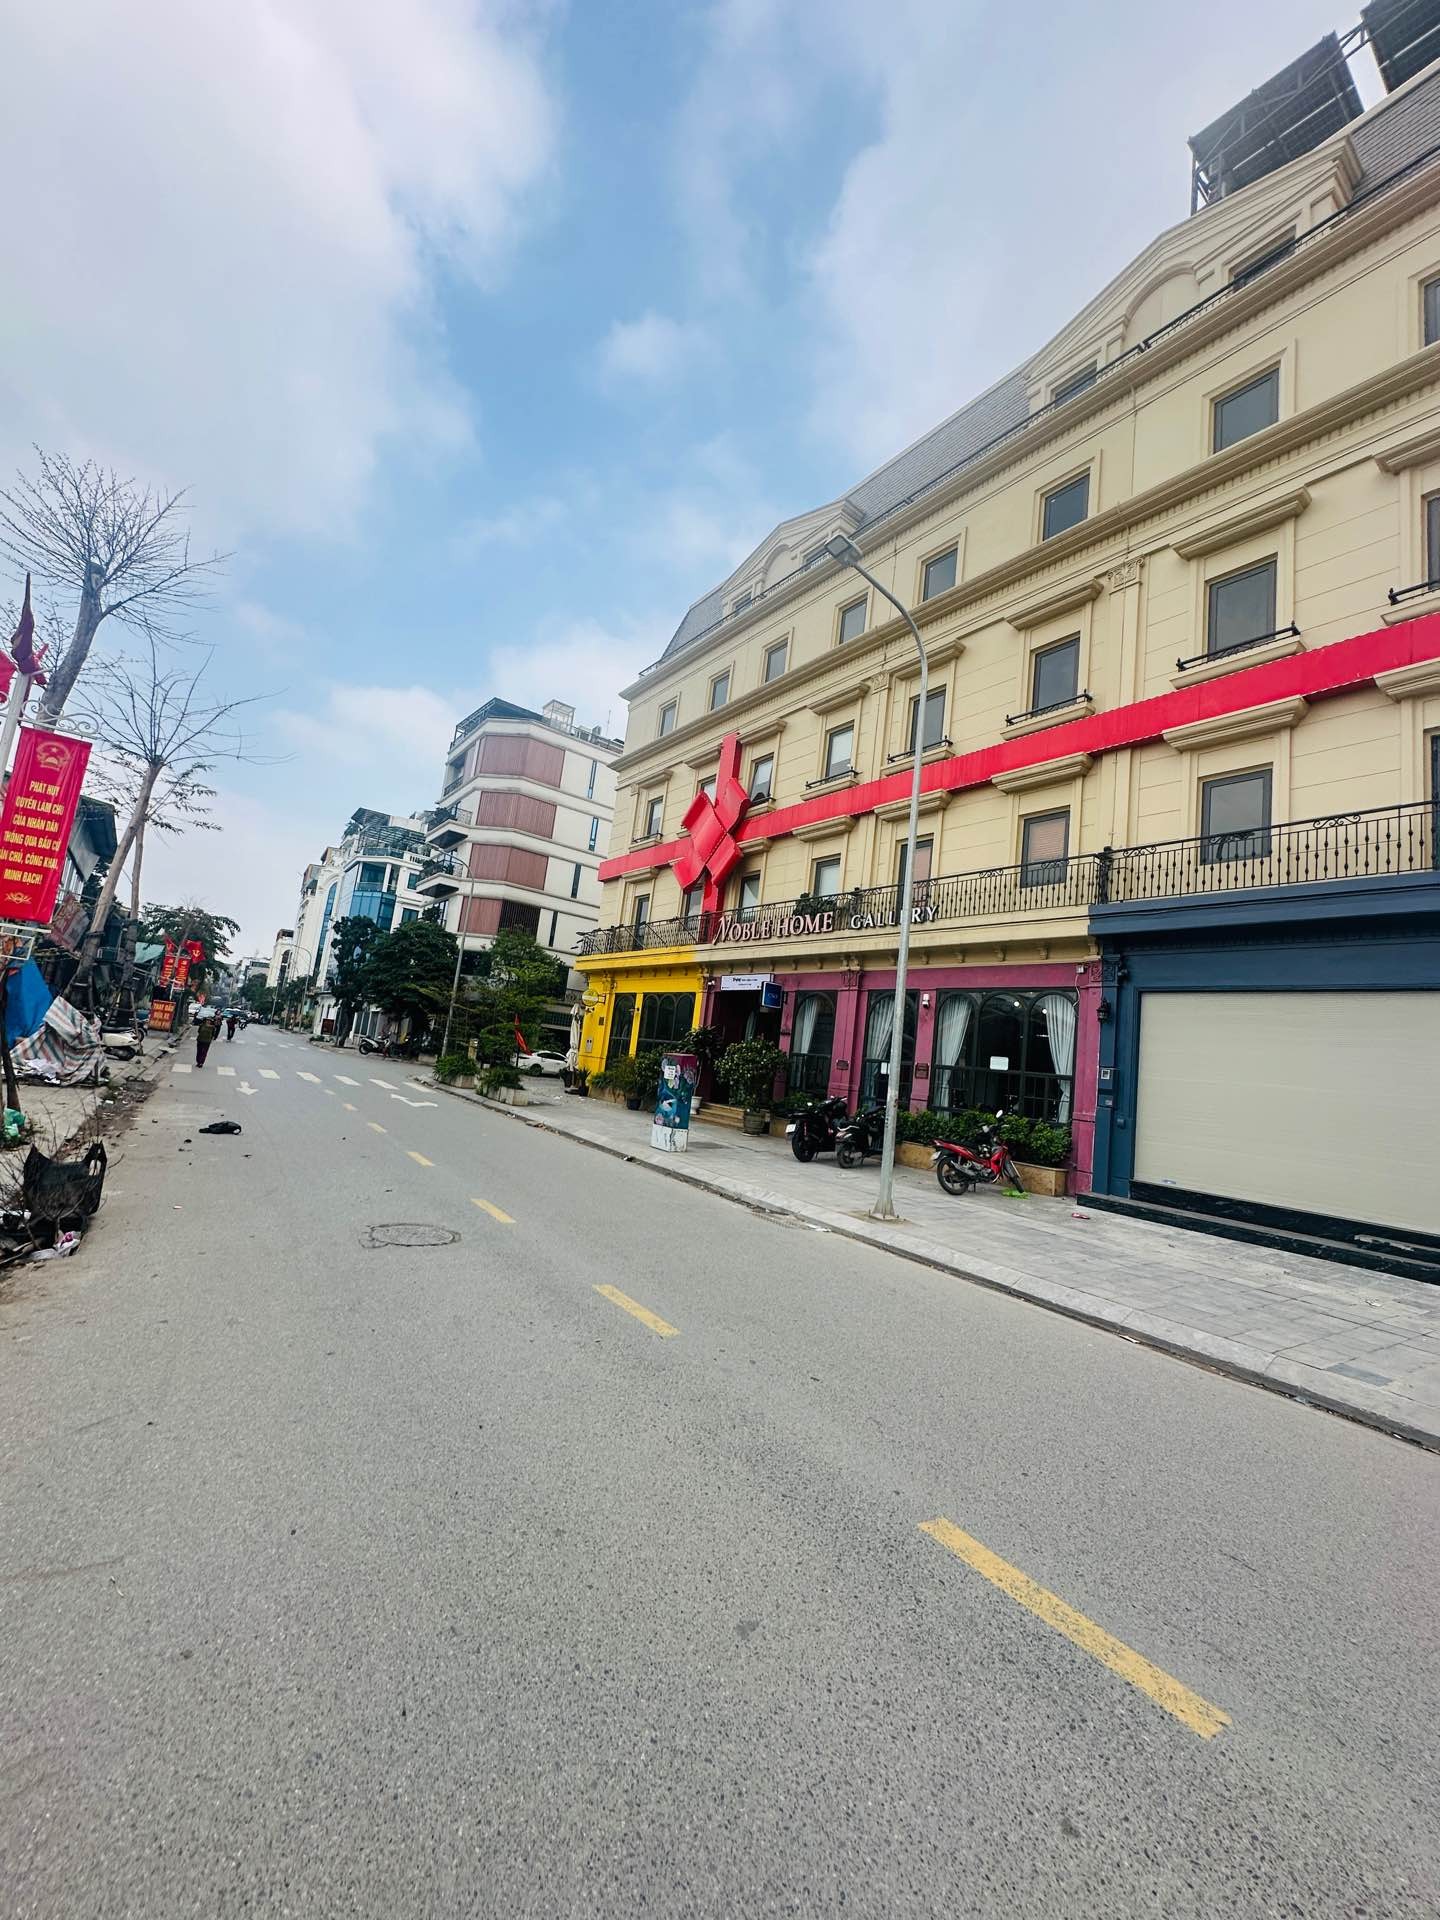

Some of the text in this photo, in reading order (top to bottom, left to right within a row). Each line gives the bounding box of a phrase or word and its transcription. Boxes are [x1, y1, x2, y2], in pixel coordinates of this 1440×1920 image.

[712, 906, 937, 945] NOBLE HOME GALLRY
